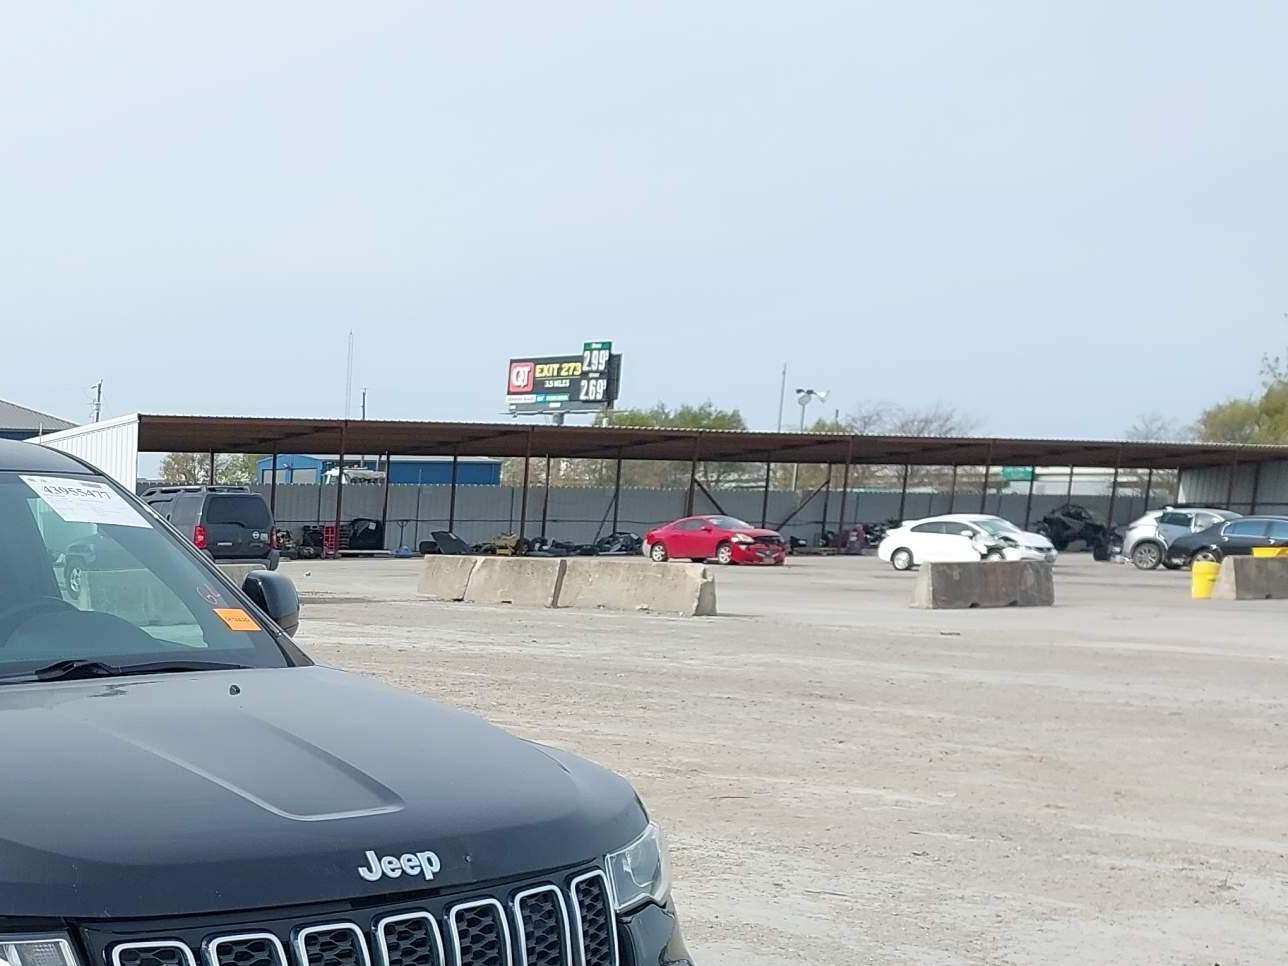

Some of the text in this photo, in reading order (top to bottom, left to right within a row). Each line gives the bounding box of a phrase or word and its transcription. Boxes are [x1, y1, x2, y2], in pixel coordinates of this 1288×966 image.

[535, 363, 560, 377] EXIT
[560, 362, 582, 376] 273
[43, 484, 111, 500] 43955477
[358, 850, 441, 881] Jeep
